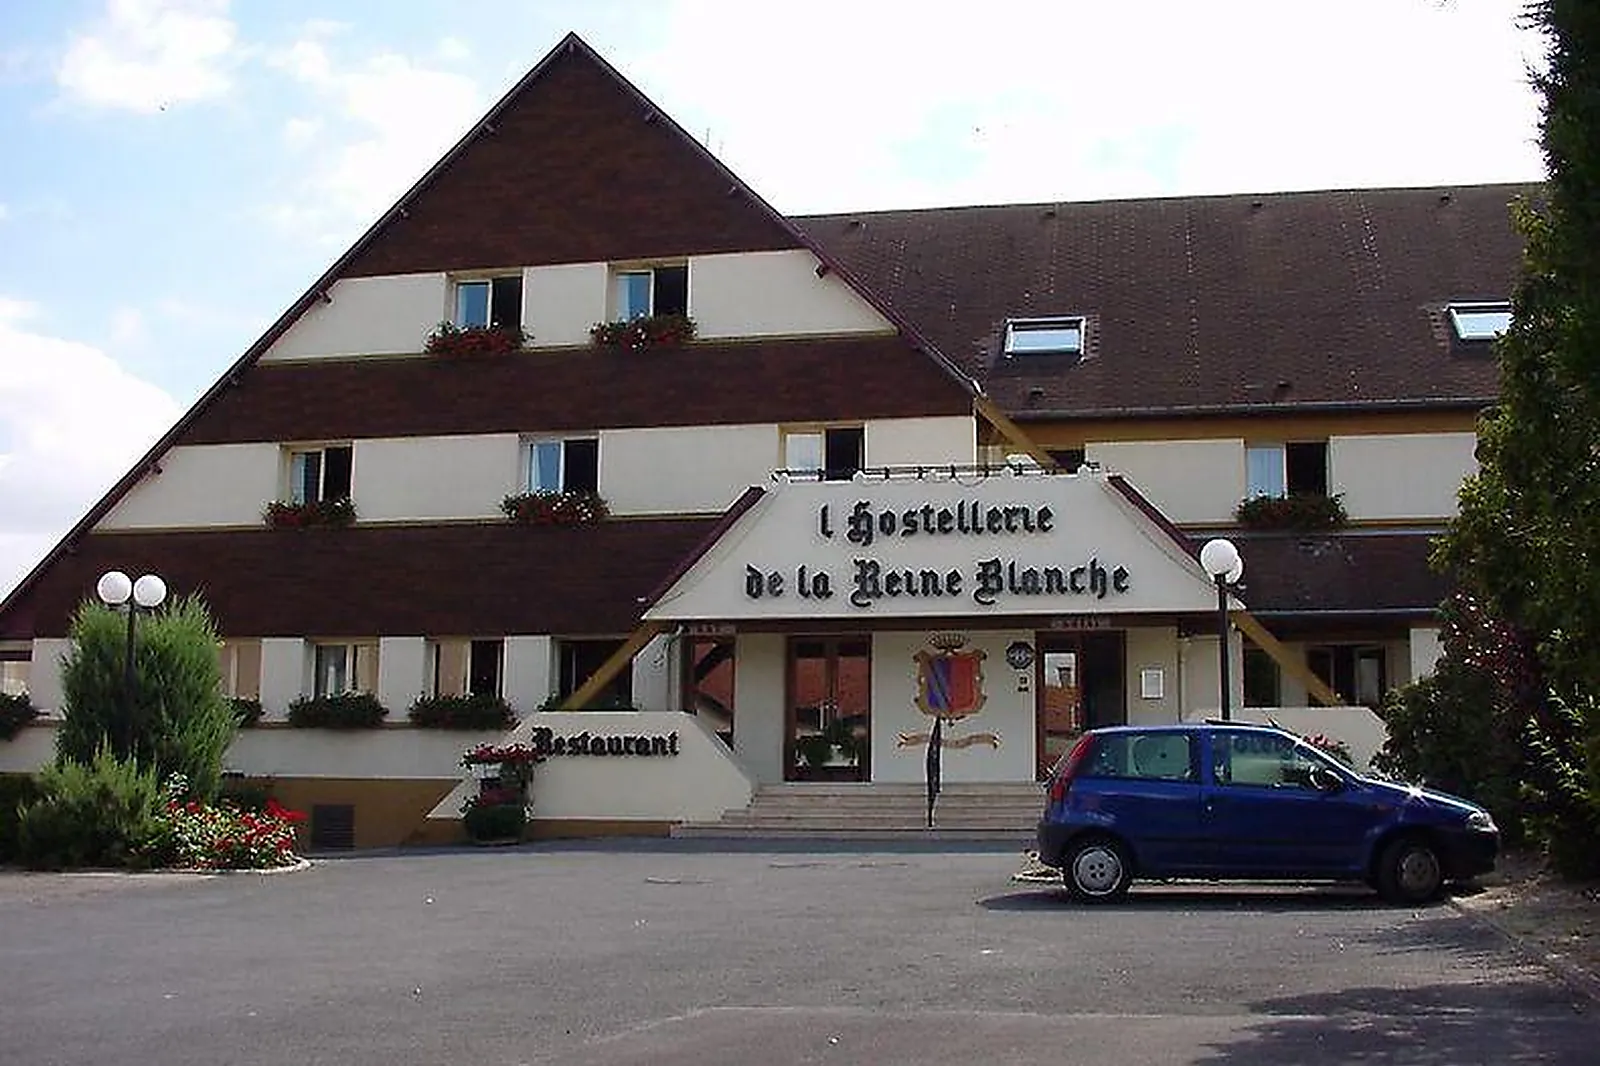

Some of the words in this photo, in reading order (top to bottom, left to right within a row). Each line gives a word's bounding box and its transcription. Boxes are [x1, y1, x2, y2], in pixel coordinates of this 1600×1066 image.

[846, 500, 1054, 547] Hostellerie
[746, 563, 784, 599] de
[797, 564, 834, 599] la
[850, 558, 962, 607] Reine
[973, 557, 1129, 605] Blanche
[531, 726, 679, 763] Restaurant
